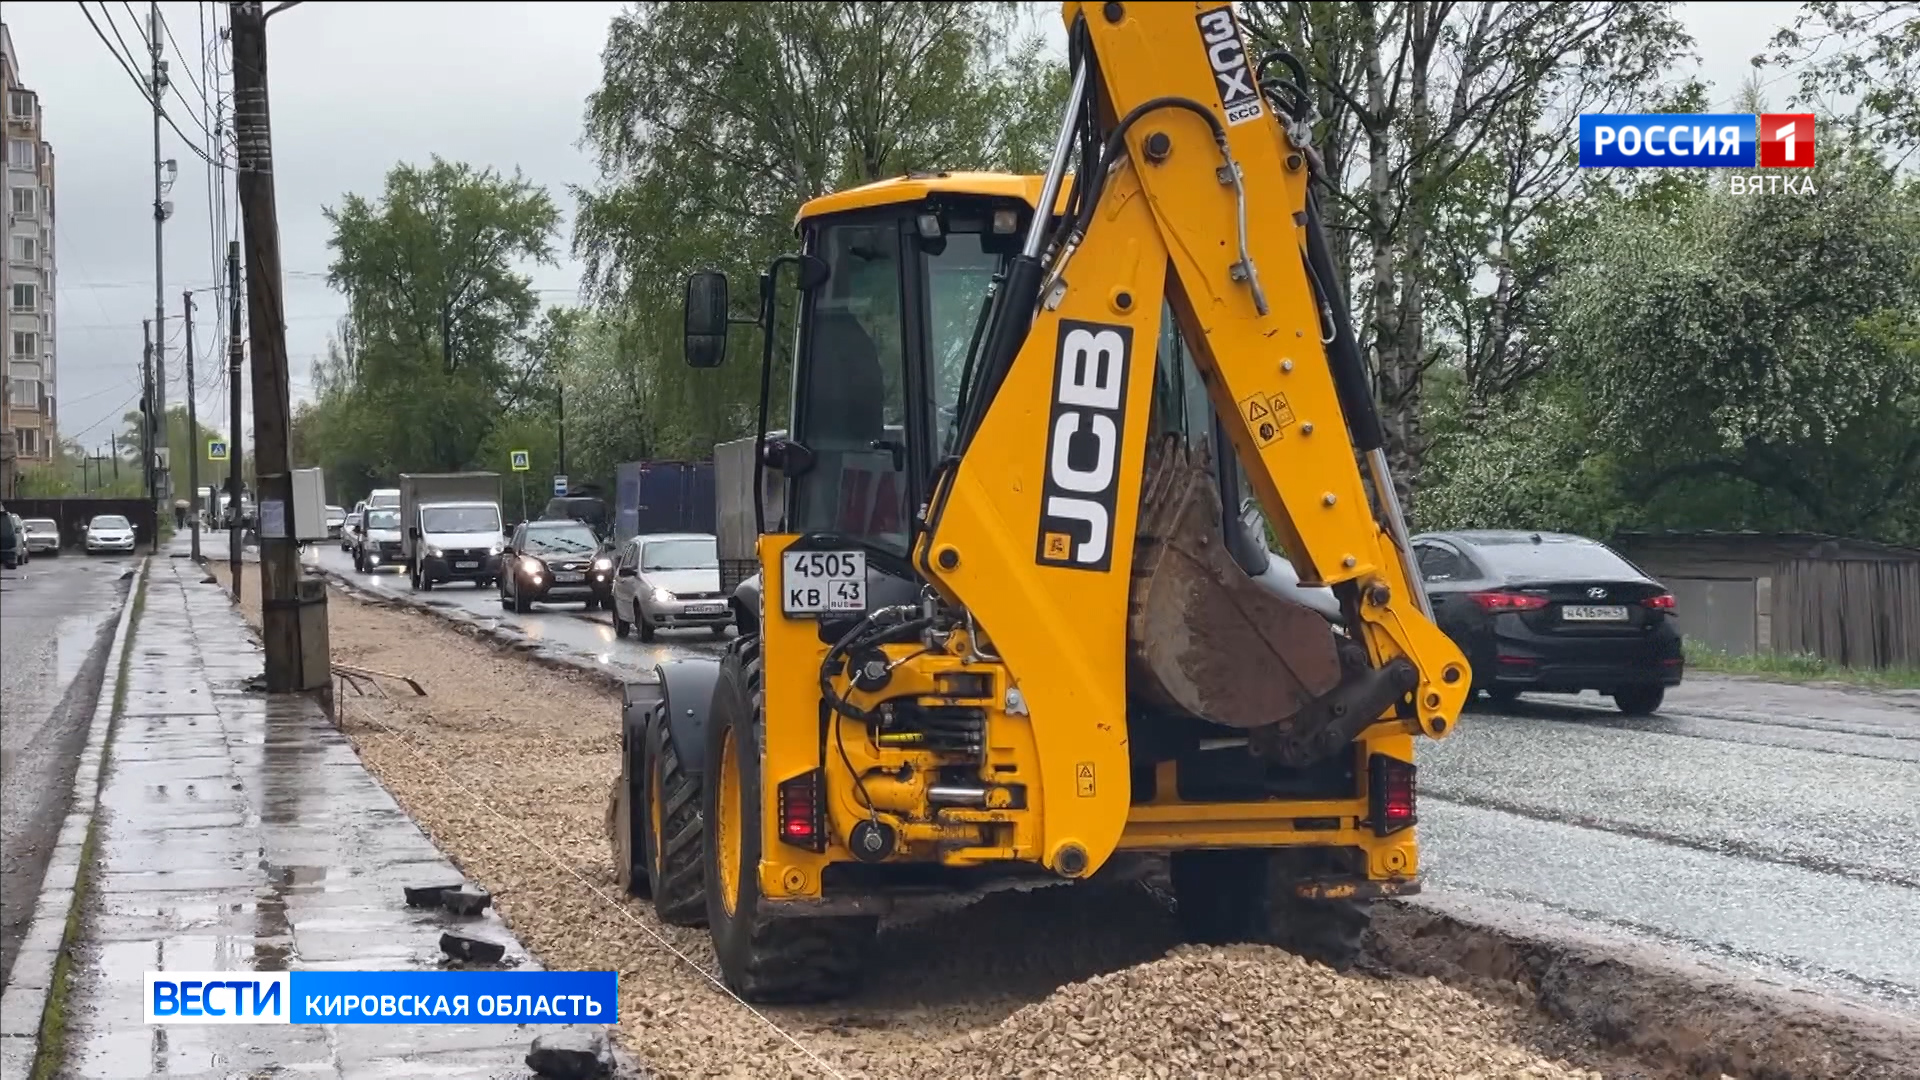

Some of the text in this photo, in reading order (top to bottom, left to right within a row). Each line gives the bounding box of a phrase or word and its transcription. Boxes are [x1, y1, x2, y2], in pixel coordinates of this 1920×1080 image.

[1201, 10, 1255, 102] 3CX
[1228, 104, 1260, 122] ECO
[1047, 328, 1124, 563] JCB
[794, 553, 856, 578] 4505
[837, 583, 860, 600] 43
